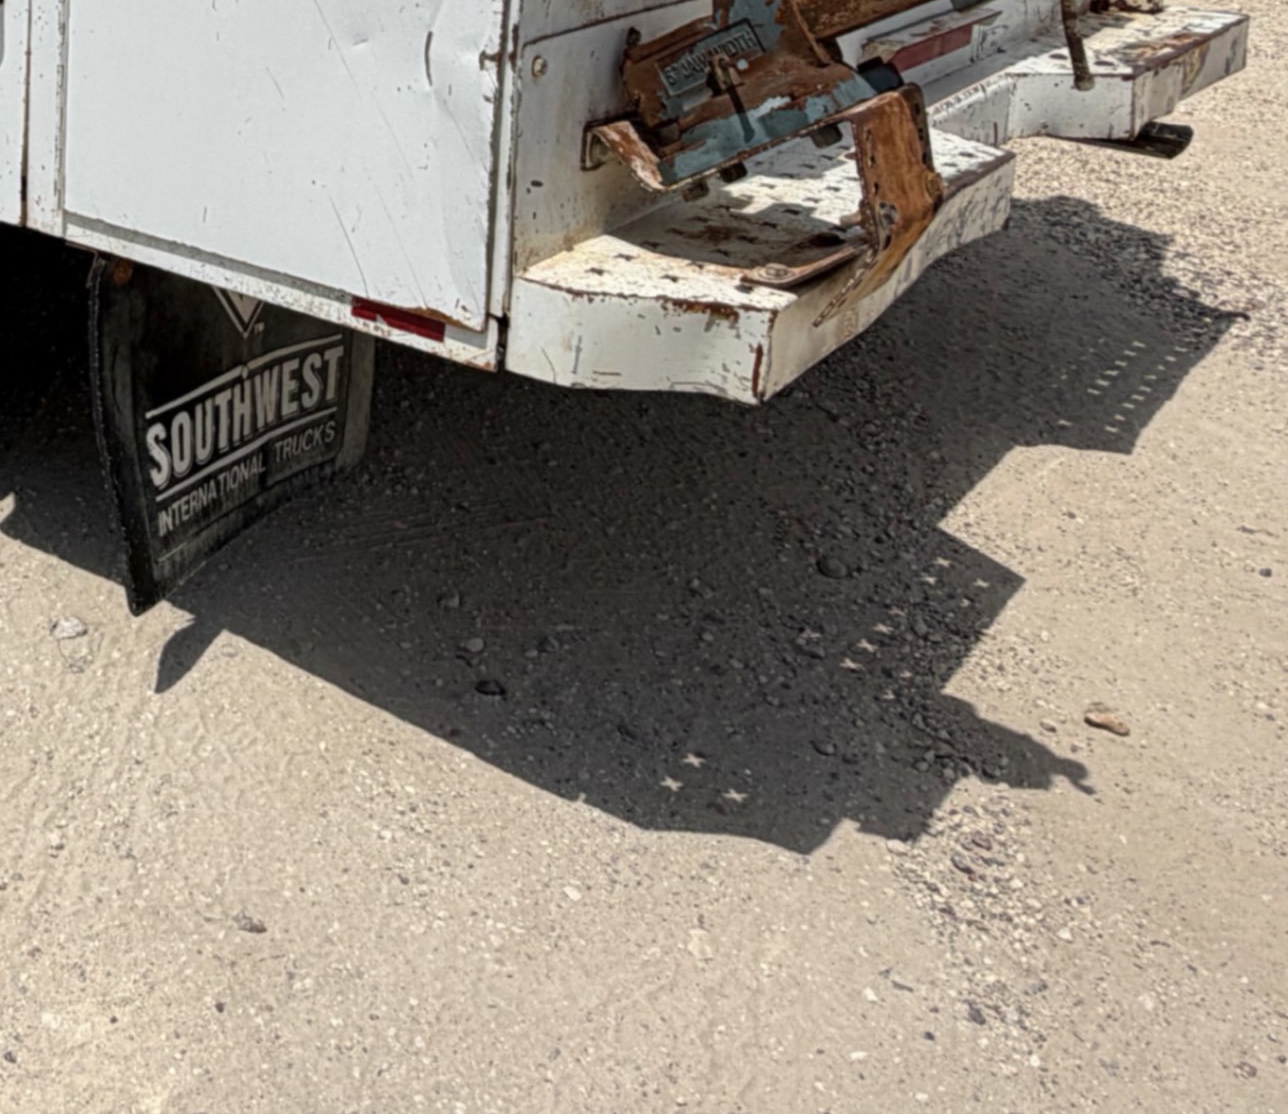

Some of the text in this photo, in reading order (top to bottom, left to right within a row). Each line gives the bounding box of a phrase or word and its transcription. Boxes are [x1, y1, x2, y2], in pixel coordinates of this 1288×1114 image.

[146, 346, 344, 489] SOUTHWEST
[158, 420, 337, 537] INTERNATIONAL TRUCKS
